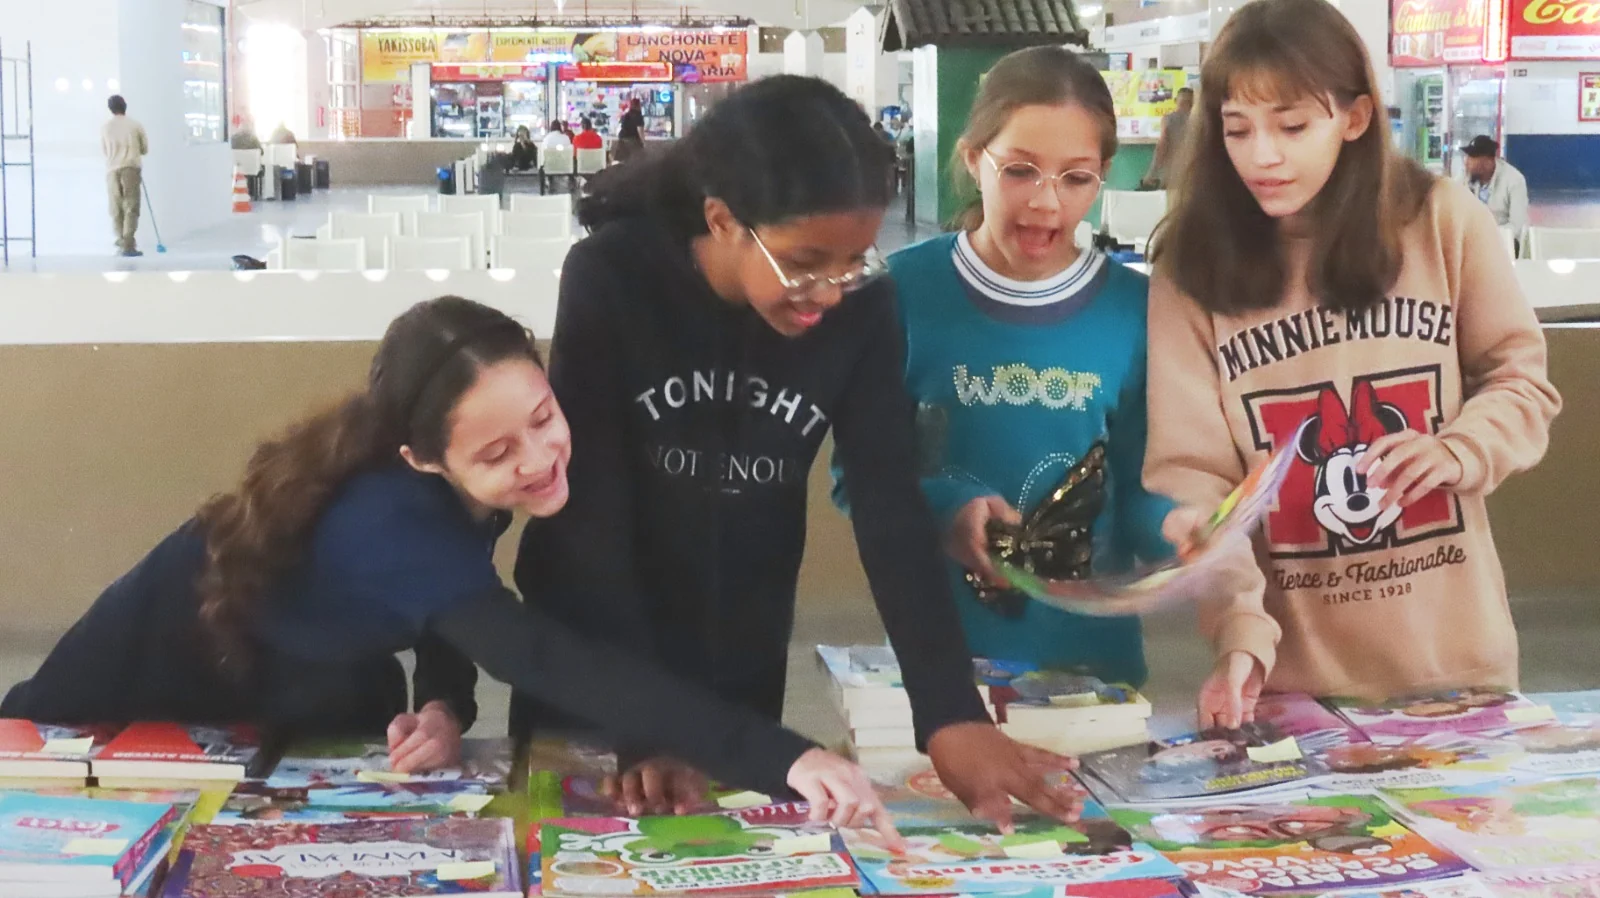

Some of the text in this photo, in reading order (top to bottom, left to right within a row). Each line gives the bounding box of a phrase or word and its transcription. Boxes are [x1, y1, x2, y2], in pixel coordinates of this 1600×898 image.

[626, 34, 739, 46] LANCHONETE
[658, 50, 706, 62] NOVA
[1219, 296, 1452, 382] MINNIE MOUSE
[635, 370, 827, 436] TONIGHT
[1327, 571, 1343, 588] &
[1346, 544, 1467, 585] Fashionable
[1322, 582, 1413, 605] SINCE 1928
